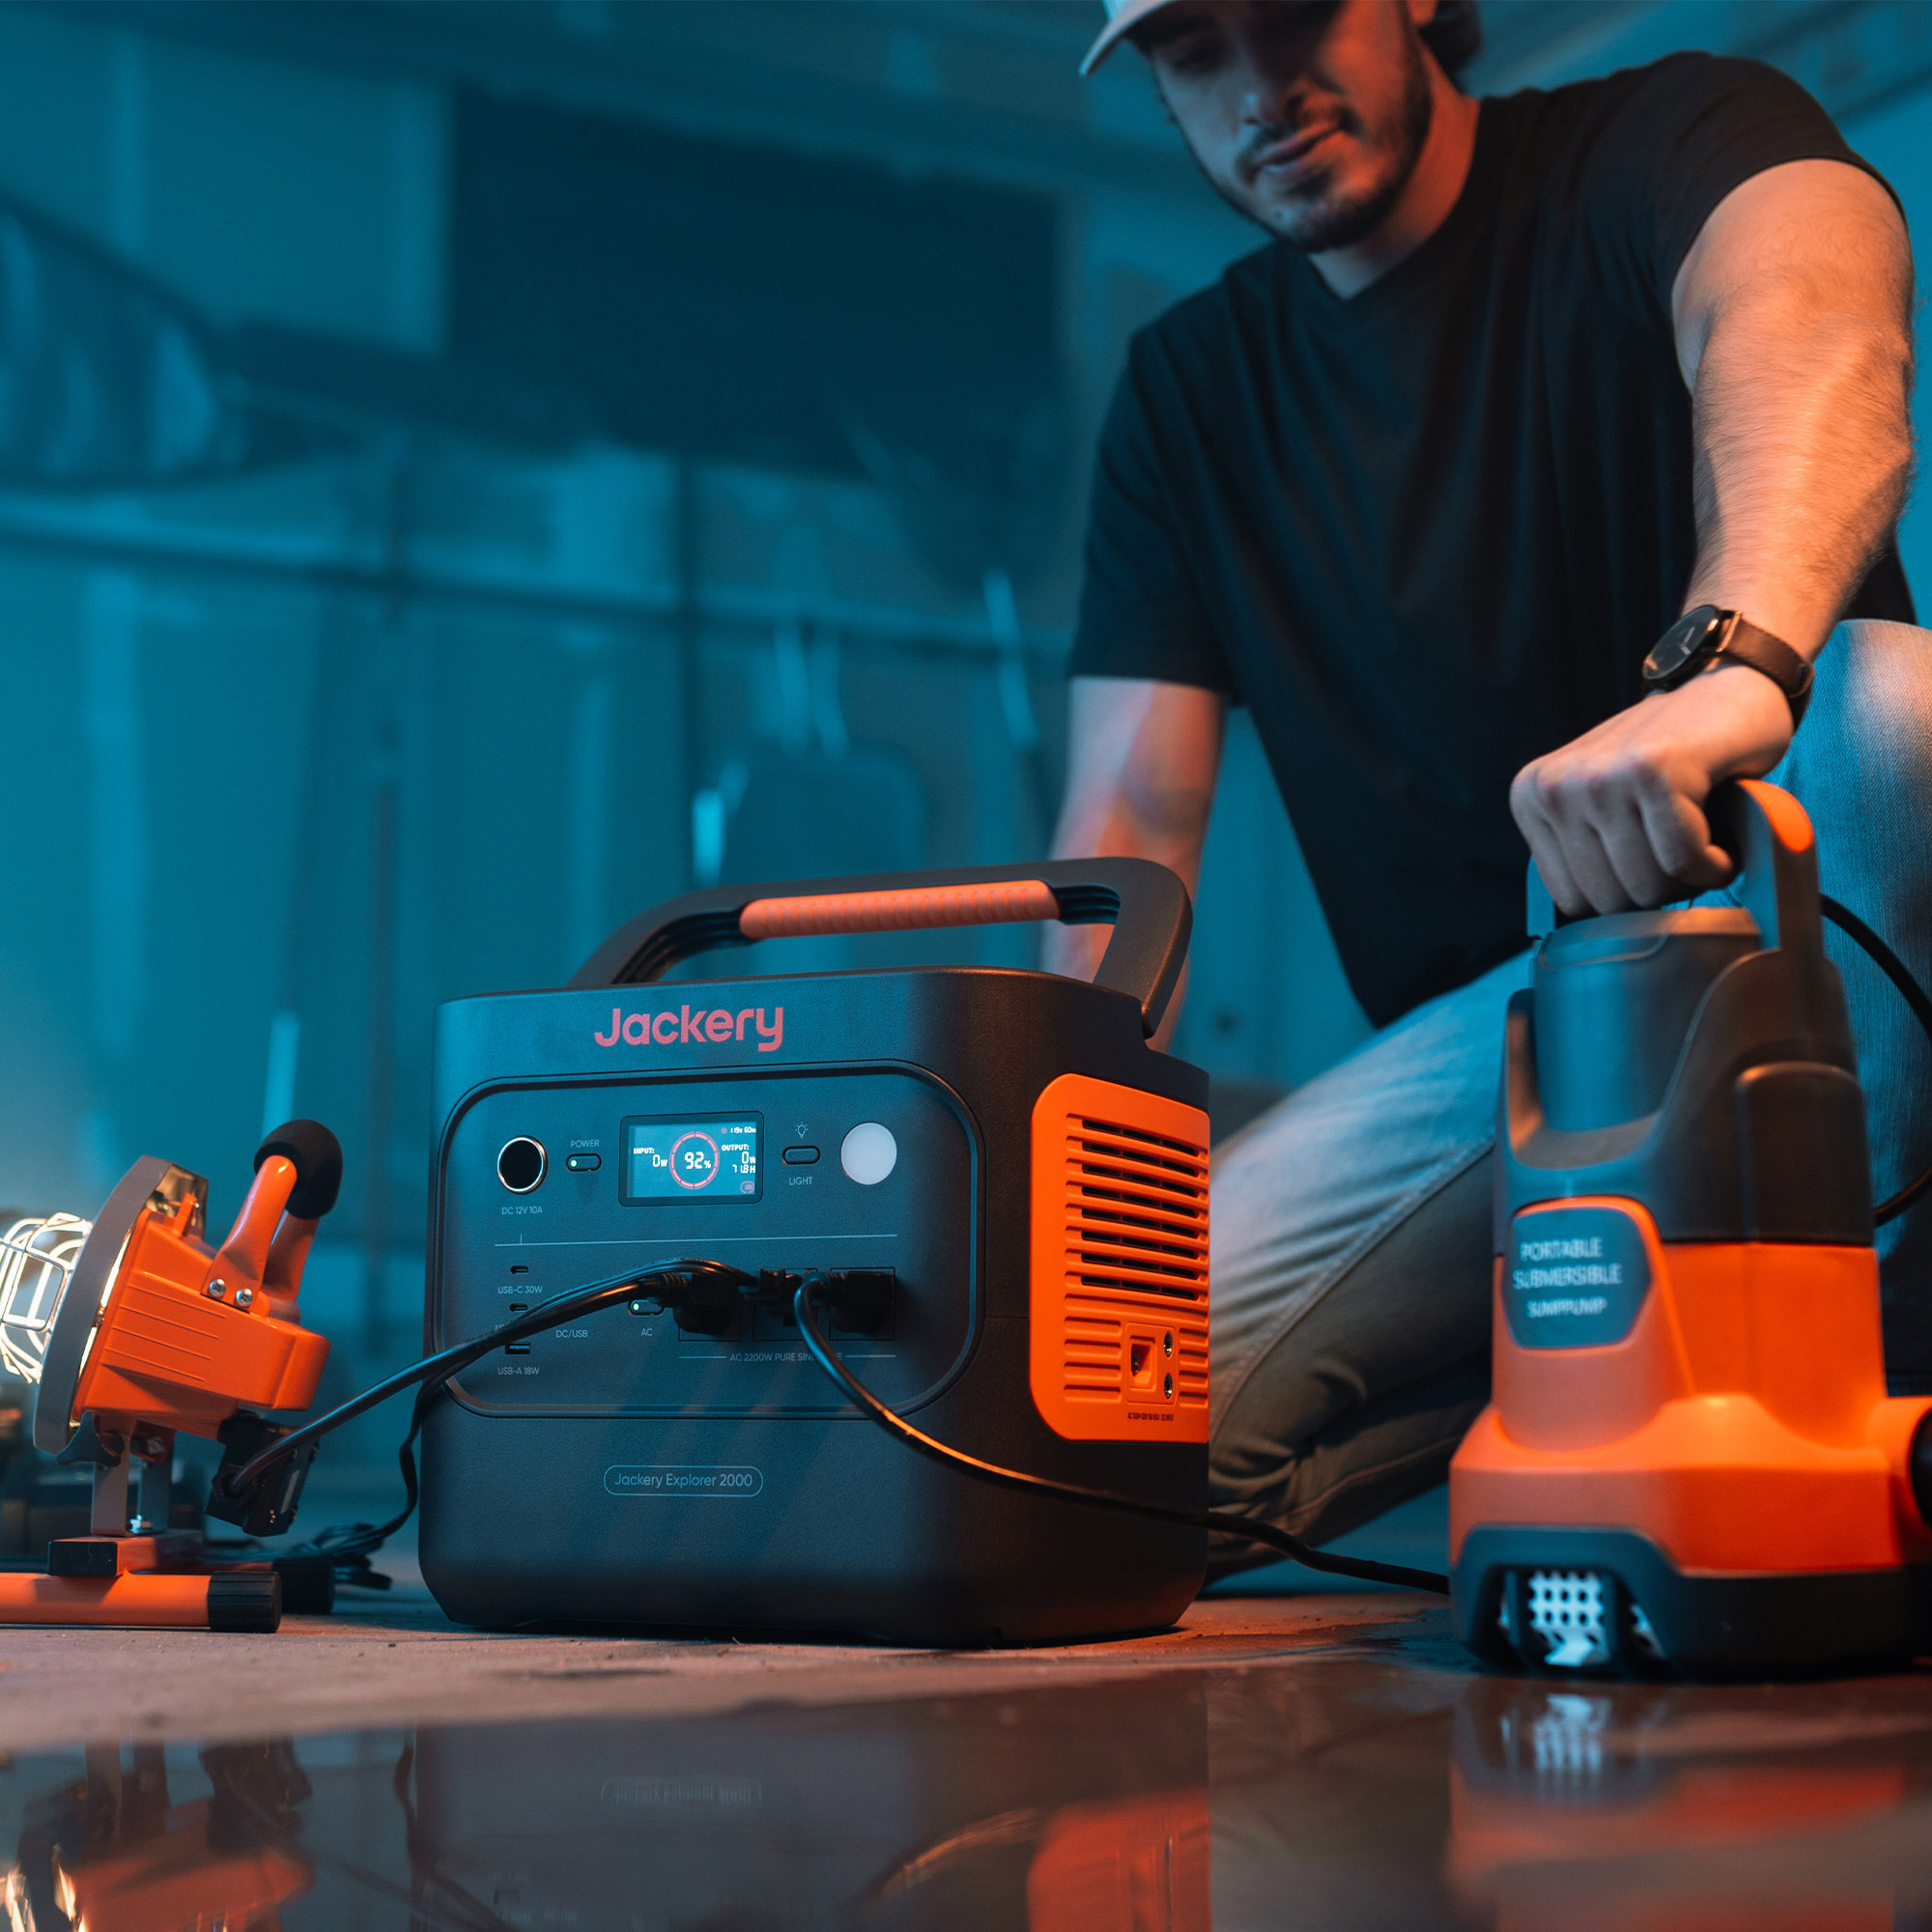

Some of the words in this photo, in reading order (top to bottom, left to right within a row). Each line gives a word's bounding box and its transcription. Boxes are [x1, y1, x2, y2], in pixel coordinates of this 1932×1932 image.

[594, 1005, 783, 1052] Jackery
[570, 1139, 600, 1148] POWER
[684, 1151, 712, 1170] 92%
[788, 1176, 813, 1186] LIGHT
[501, 1207, 514, 1215] DC
[516, 1207, 527, 1215] 12V
[529, 1206, 543, 1214] 10A
[1520, 1236, 1604, 1262] PORTABLE
[1513, 1263, 1624, 1290] SUBMERSIBLE
[497, 1286, 524, 1294] USB-C
[525, 1285, 543, 1293] 30W
[555, 1329, 588, 1339] DC/USB
[640, 1328, 653, 1337] AC
[729, 1353, 742, 1362] AC
[744, 1353, 773, 1362] 2200W
[775, 1353, 796, 1362] PURE
[497, 1367, 522, 1376] USB-A
[614, 1473, 664, 1489] Jackery
[666, 1473, 717, 1489] Explorer
[719, 1473, 753, 1487] 2000
